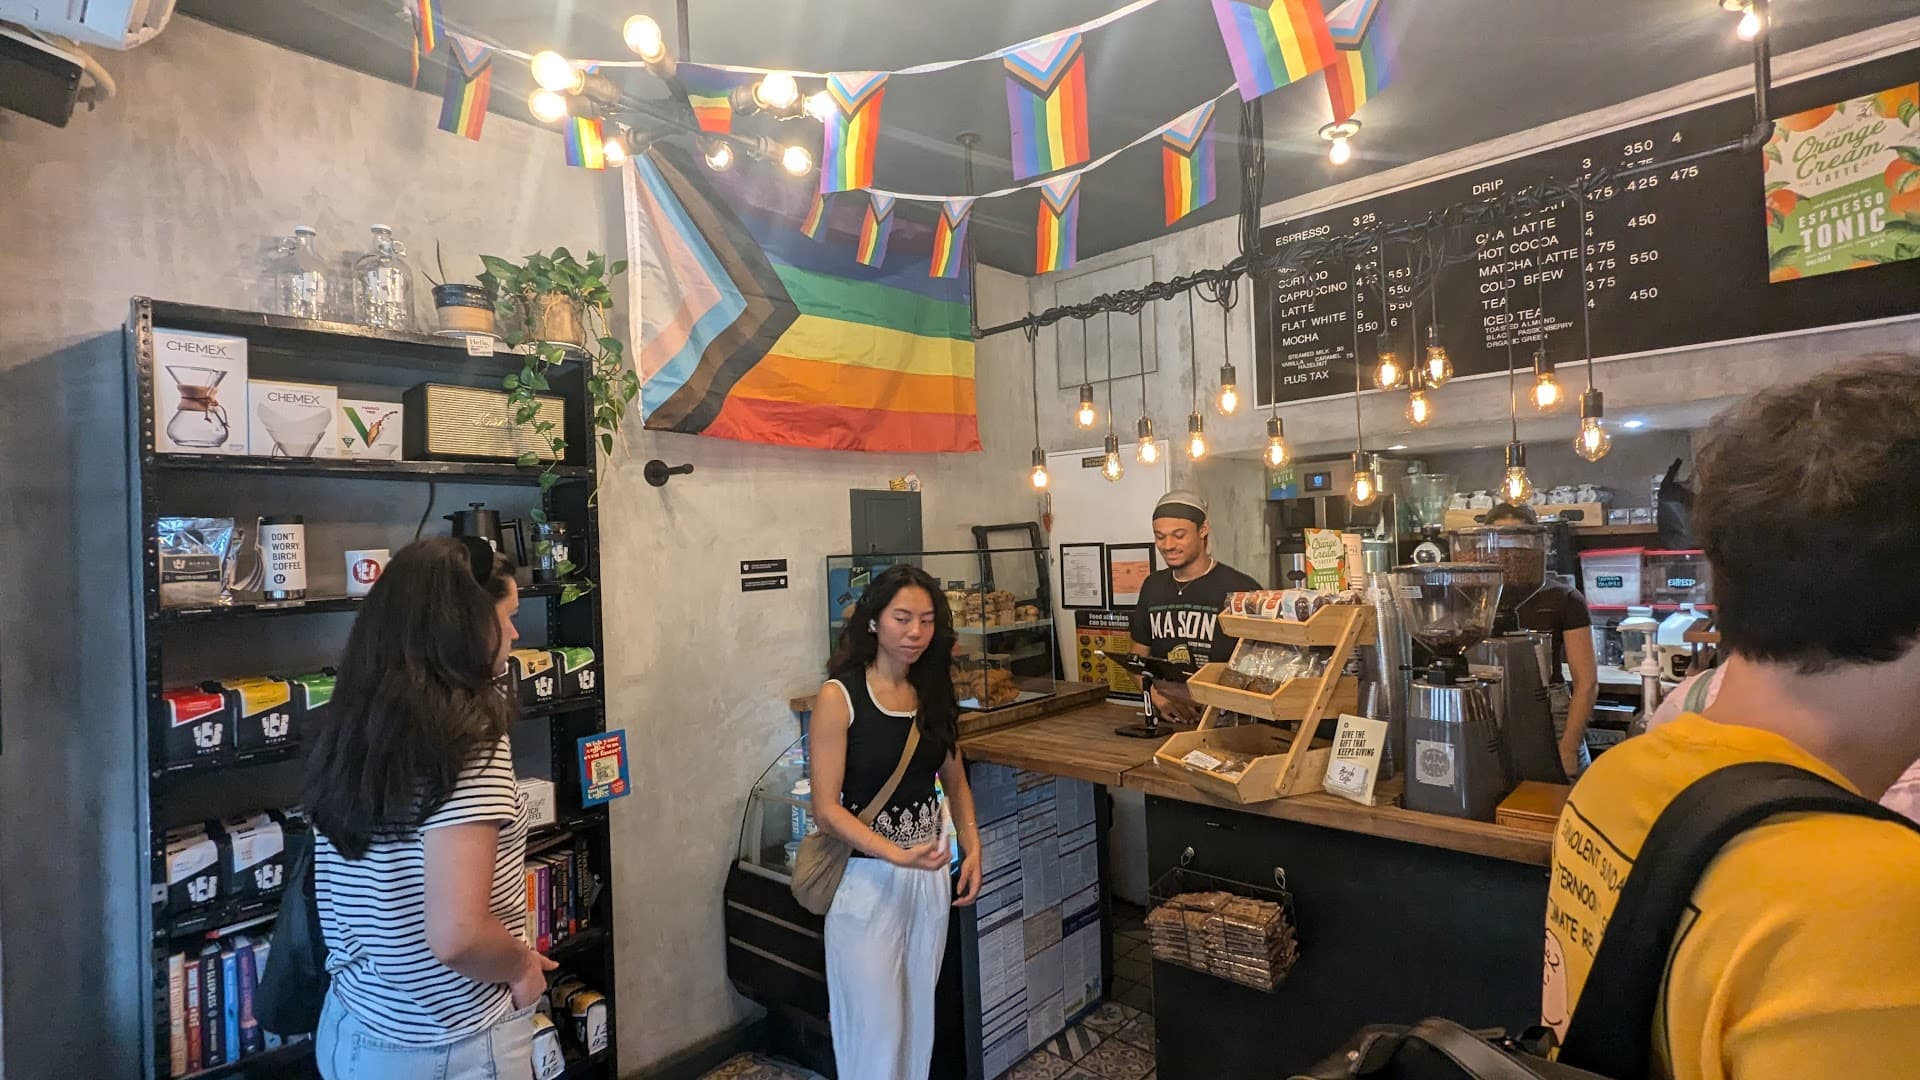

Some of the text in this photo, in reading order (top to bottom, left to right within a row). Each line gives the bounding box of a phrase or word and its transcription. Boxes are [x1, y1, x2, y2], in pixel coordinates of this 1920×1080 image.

[1792, 119, 1887, 162] Orange
[1472, 179, 1504, 196] DRIP
[1582, 158, 1592, 169] 3
[1623, 140, 1654, 156] 350
[1671, 131, 1683, 143] 4
[1796, 141, 1885, 180] Cream
[1626, 175, 1658, 191] 425
[1670, 165, 1699, 181] 475
[1816, 163, 1859, 186] LATTE
[1798, 191, 1884, 229] ESPRESSO
[1512, 217, 1556, 236] LATTE
[1585, 210, 1595, 221] 5
[1800, 207, 1886, 253] TONIC
[1275, 224, 1331, 247] ESPRESSO
[1478, 213, 1657, 261] HOT COCOA 4 450
[1479, 258, 1533, 278] MATCHA
[1536, 247, 1580, 265] LATTE
[1480, 278, 1516, 294] COLD
[1523, 268, 1564, 286] BREW
[1629, 250, 1659, 265] 550
[1281, 303, 1316, 318] LATTE
[1357, 292, 1365, 302] 5
[1481, 297, 1507, 310] TEA
[1483, 287, 1658, 327] ICED TEA 4 450
[1281, 319, 1307, 333] FLAT
[1311, 311, 1347, 327] WHITE
[1357, 309, 1364, 320] 5
[1282, 317, 1398, 347] MOCHA 550 6
[1521, 316, 1556, 328] ALMND
[1486, 332, 1509, 341] BLAC
[1486, 337, 1520, 349] ORGAIC
[166, 340, 227, 357] CHEMEX
[1283, 369, 1329, 385] PLUS TAX
[267, 391, 321, 405] CHEMEX
[271, 532, 296, 541] DON'T
[272, 552, 298, 561] BIRCH
[272, 561, 302, 571] COFFEE
[1149, 610, 1218, 642] MASON
[1340, 739, 1367, 748] GIFT THAT
[1341, 730, 1366, 739] GIVE THE
[1337, 748, 1375, 757] KEEPS GIVING
